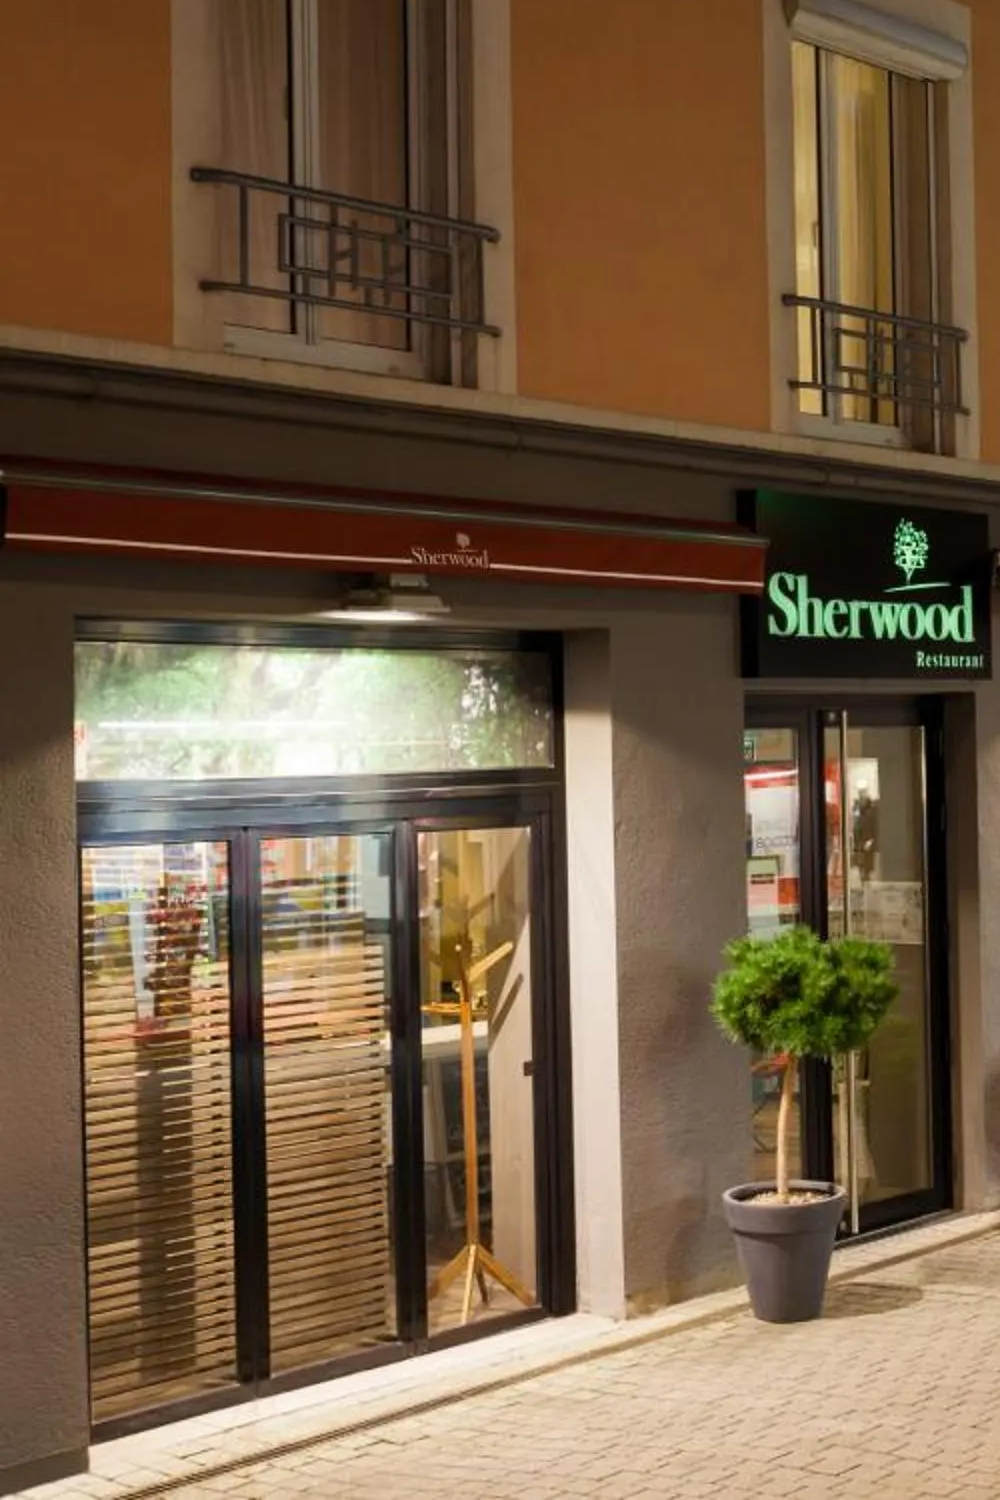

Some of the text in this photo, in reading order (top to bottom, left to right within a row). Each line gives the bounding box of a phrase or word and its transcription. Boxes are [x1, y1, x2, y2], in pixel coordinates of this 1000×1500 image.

[410, 547, 489, 571] Sherwood
[767, 571, 975, 643] Sherwood
[916, 650, 984, 669] Restaurant
